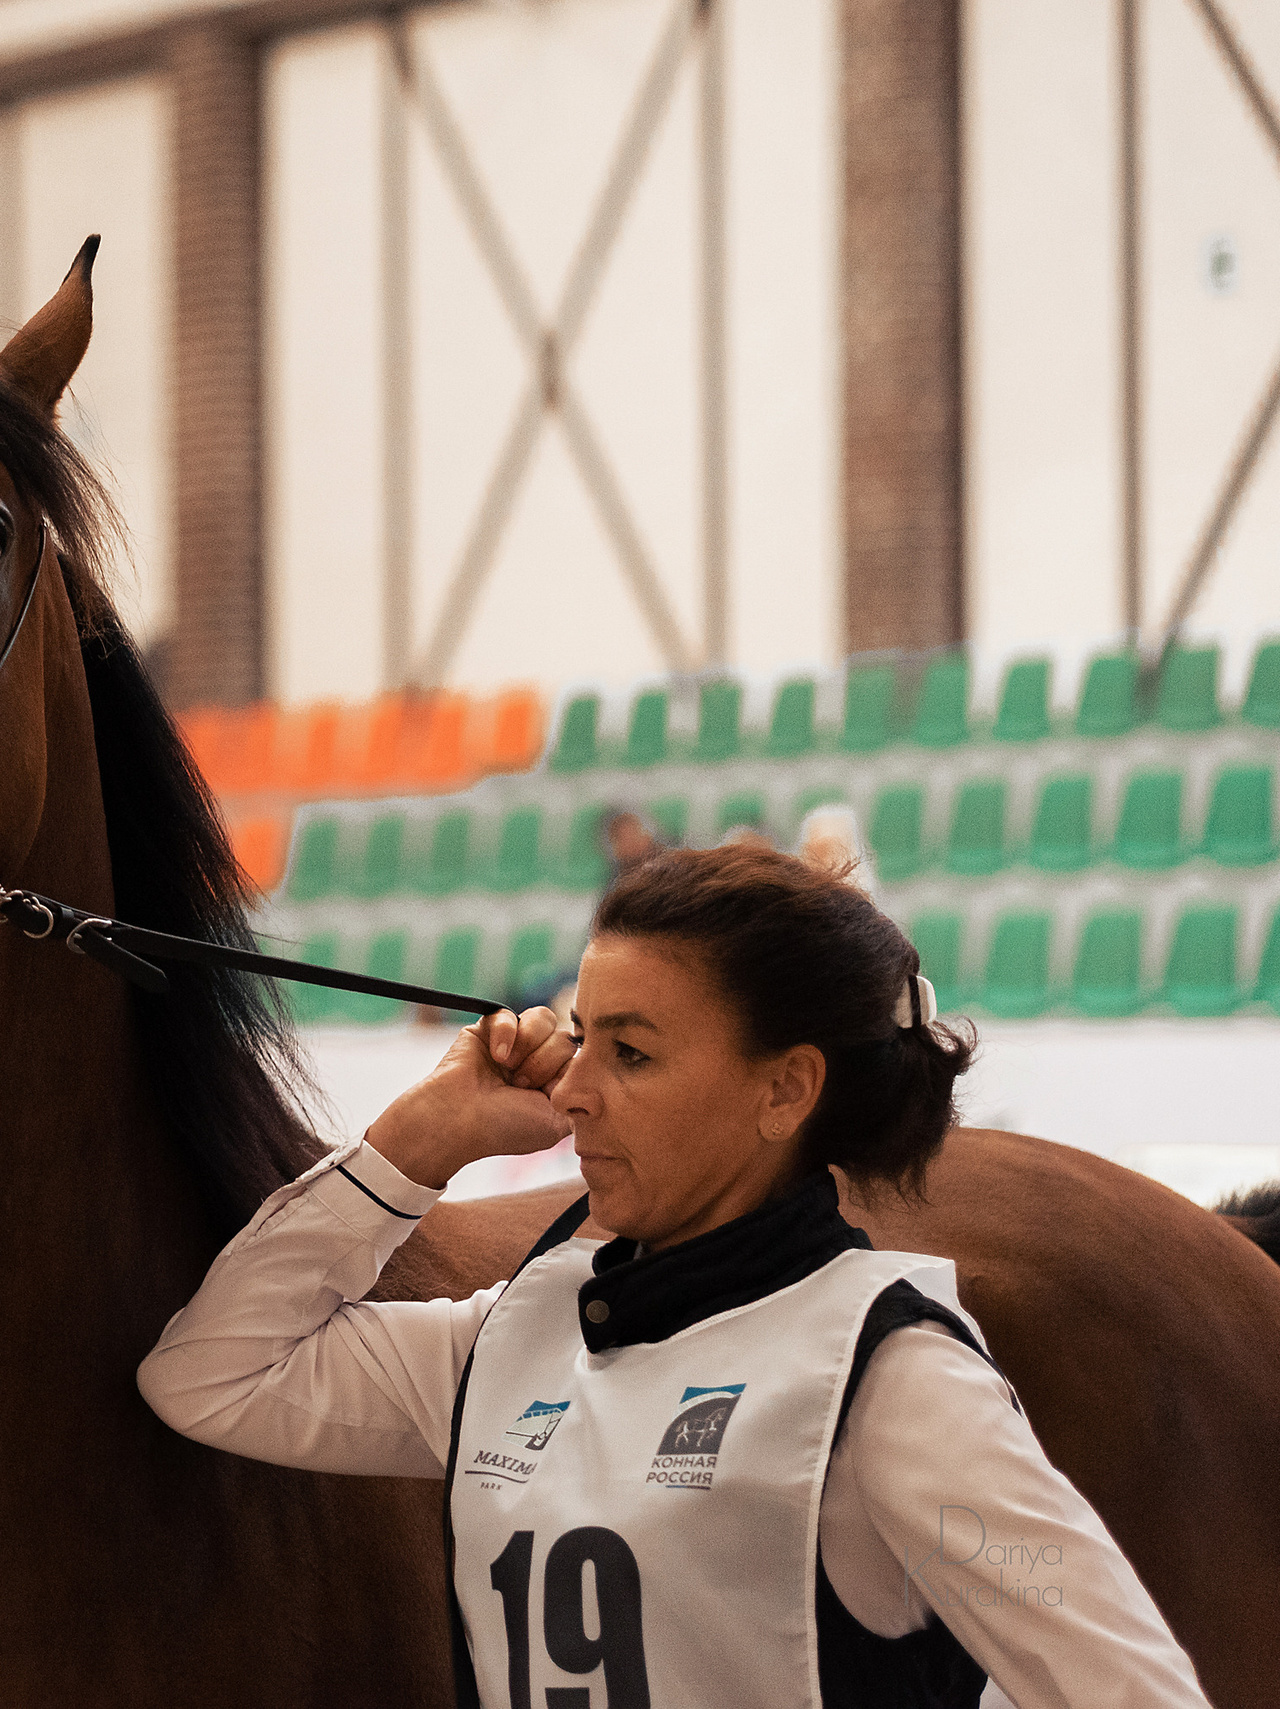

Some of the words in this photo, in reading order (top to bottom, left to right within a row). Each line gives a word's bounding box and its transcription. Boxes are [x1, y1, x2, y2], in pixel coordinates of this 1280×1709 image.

[651, 1456, 718, 1469] КОННАЯ
[645, 1471, 714, 1485] РОССИЯ
[480, 1481, 503, 1491] PARK
[489, 1525, 652, 1709] 19
